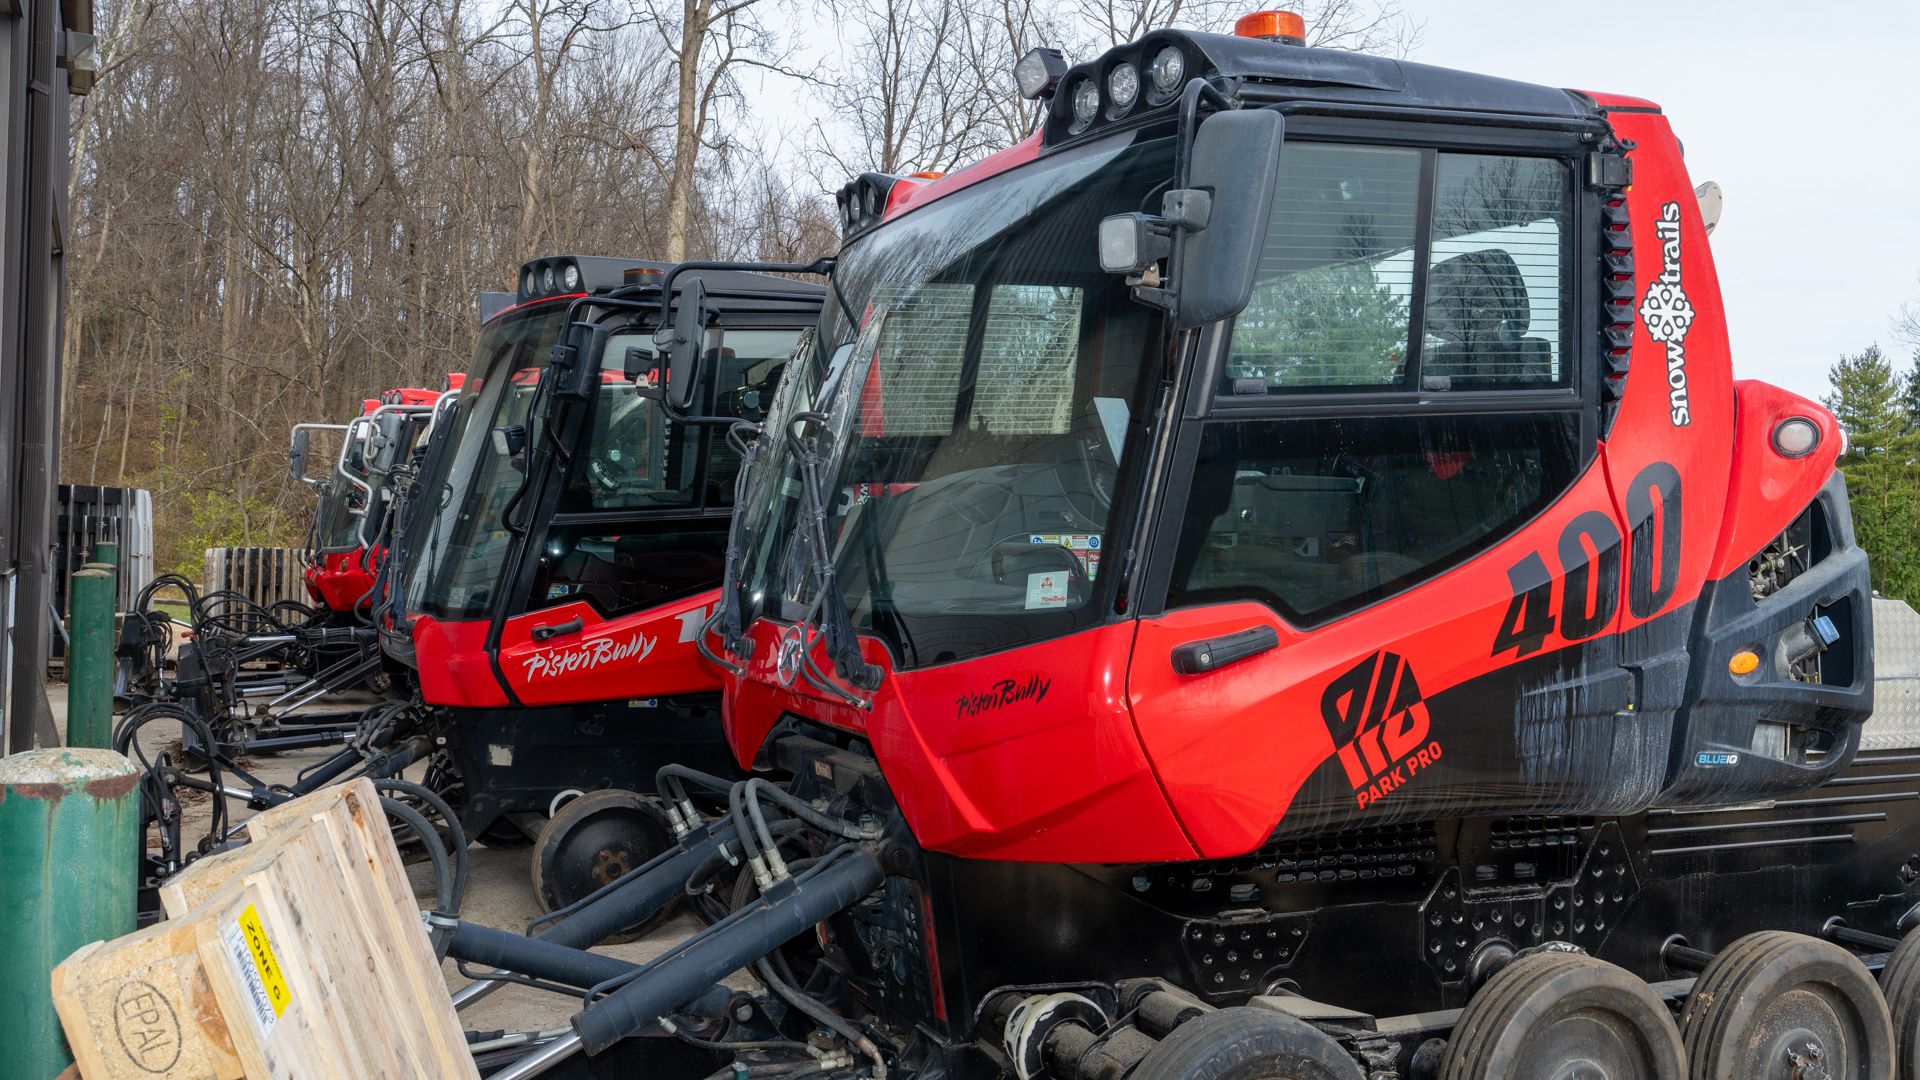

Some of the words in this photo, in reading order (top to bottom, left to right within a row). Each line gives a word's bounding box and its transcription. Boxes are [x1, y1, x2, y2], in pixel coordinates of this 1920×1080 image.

[1656, 201, 1682, 284] trails
[1666, 339, 1691, 428] snow
[1490, 461, 1682, 658] 400
[522, 631, 657, 682] PistenBully
[954, 673, 1051, 720] PistenBully
[1356, 765, 1407, 810] PARK
[1406, 741, 1443, 777] PRO
[247, 920, 274, 978] ZONE
[273, 985, 282, 1000] G
[121, 992, 171, 1063] EPAL
